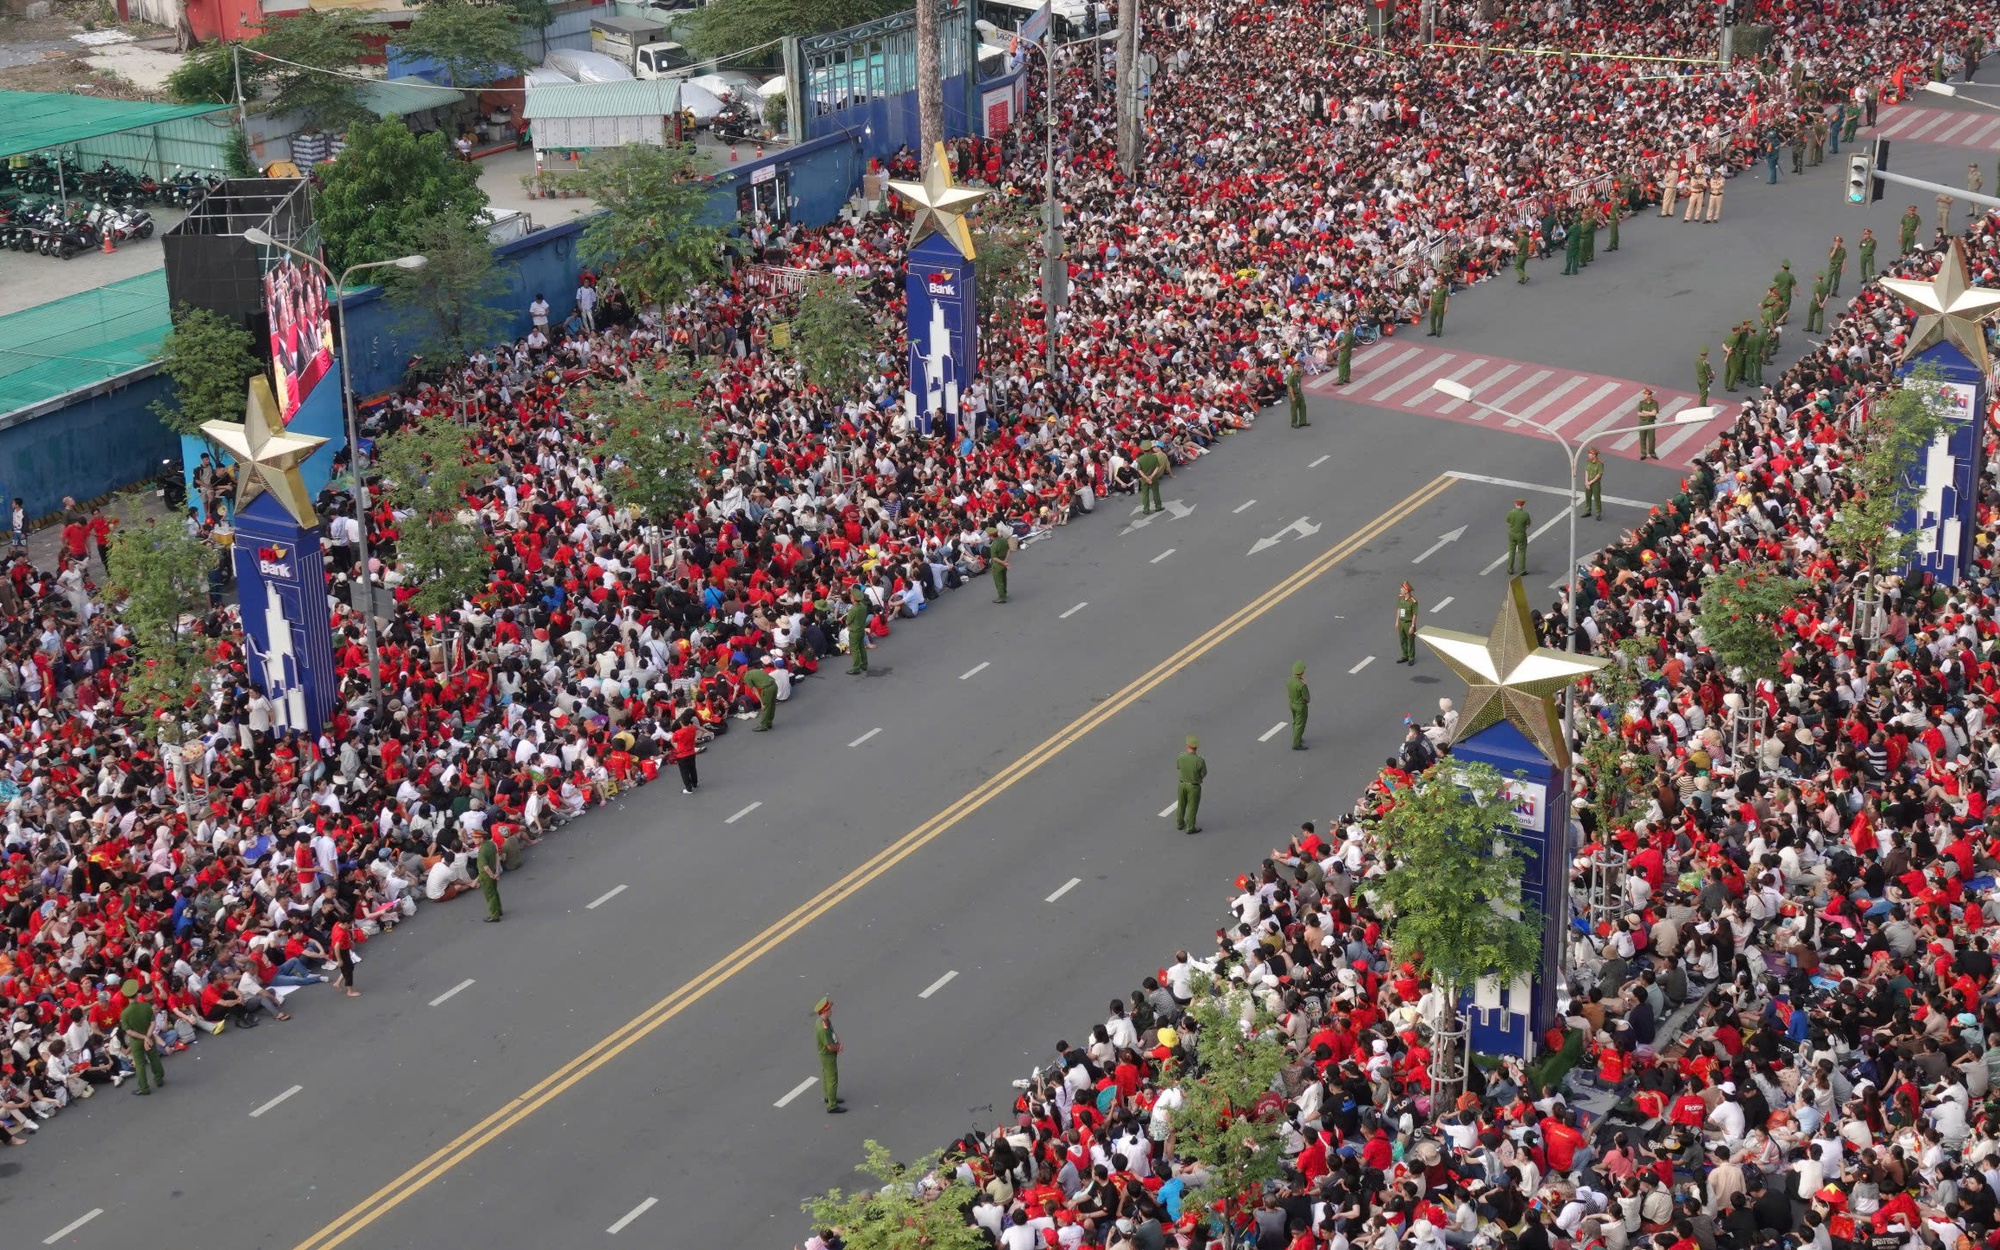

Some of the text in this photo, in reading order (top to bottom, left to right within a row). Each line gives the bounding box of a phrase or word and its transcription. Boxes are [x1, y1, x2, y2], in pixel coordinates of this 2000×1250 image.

[929, 282, 955, 295] Bank
[260, 560, 291, 578] Bank
[1516, 816, 1533, 825] ank
